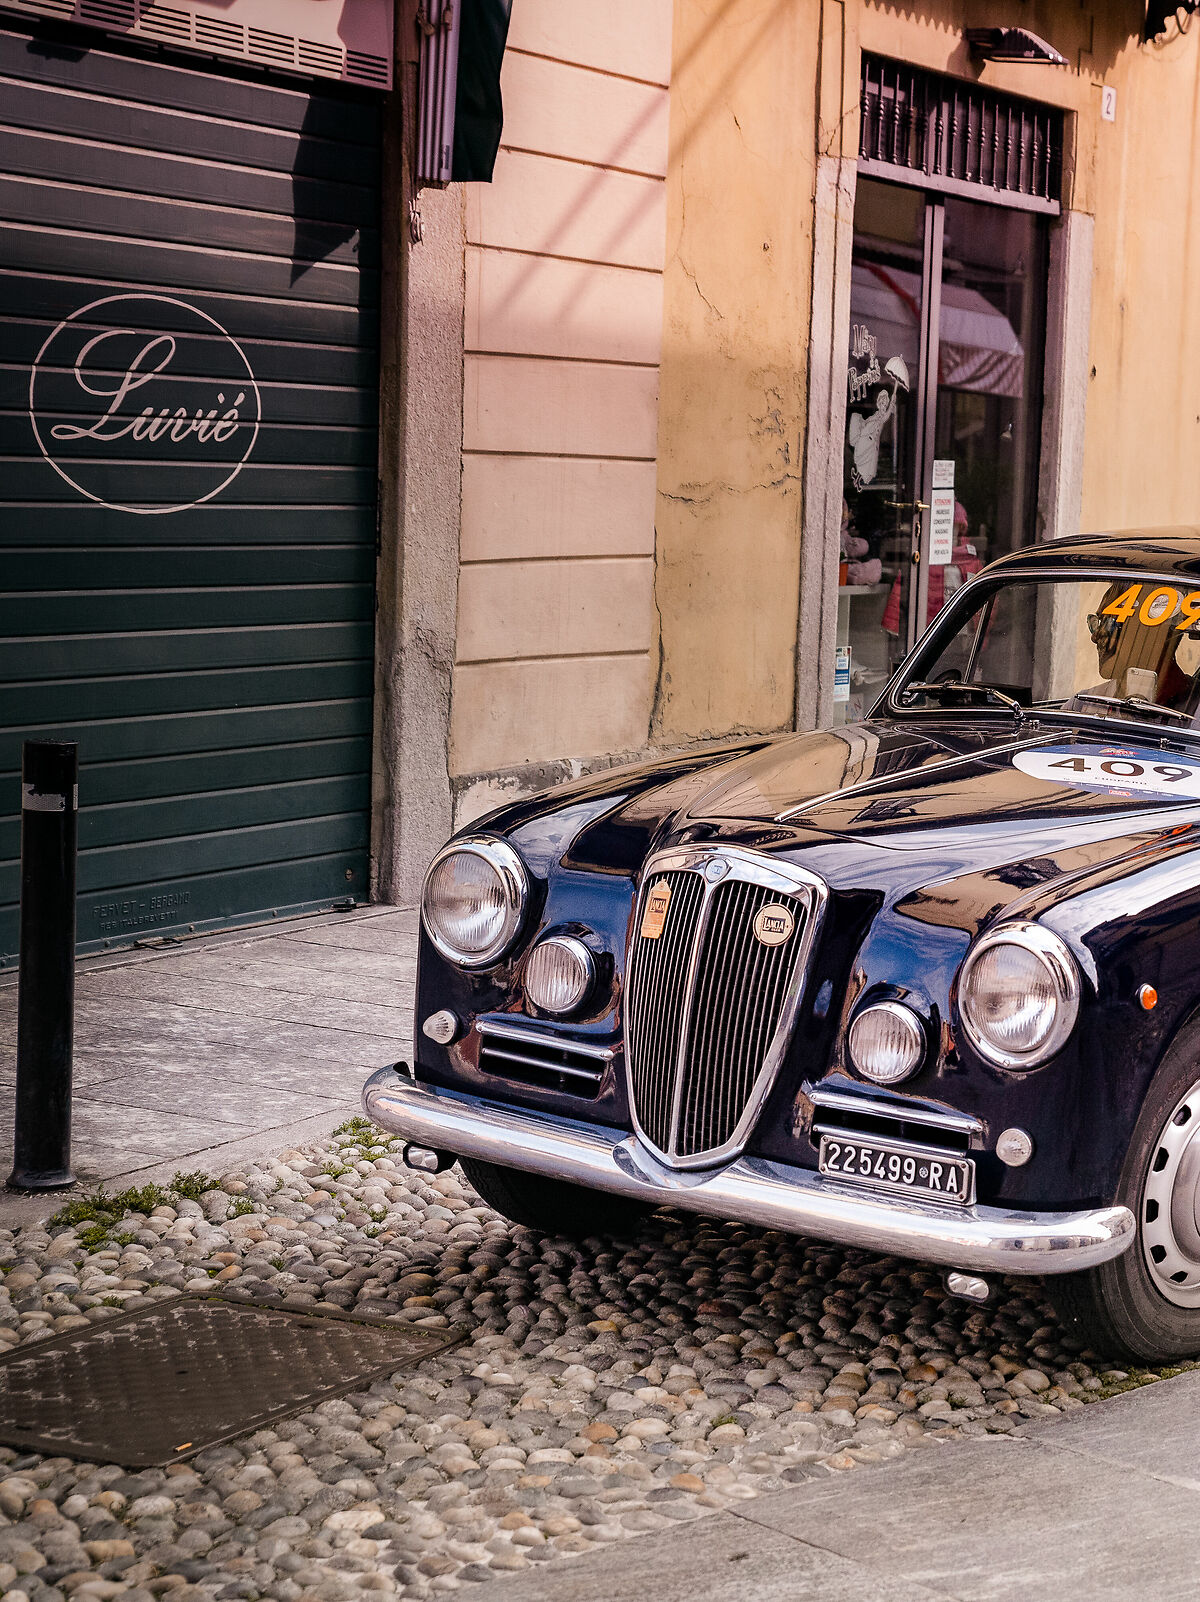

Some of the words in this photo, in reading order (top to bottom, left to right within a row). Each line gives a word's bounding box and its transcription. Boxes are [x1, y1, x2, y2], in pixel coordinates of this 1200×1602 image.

[1106, 92, 1112, 115] 2
[1047, 757, 1193, 783] 409
[762, 916, 784, 932] LANCIA
[827, 1143, 917, 1185] 225499
[929, 1162, 958, 1193] RA
